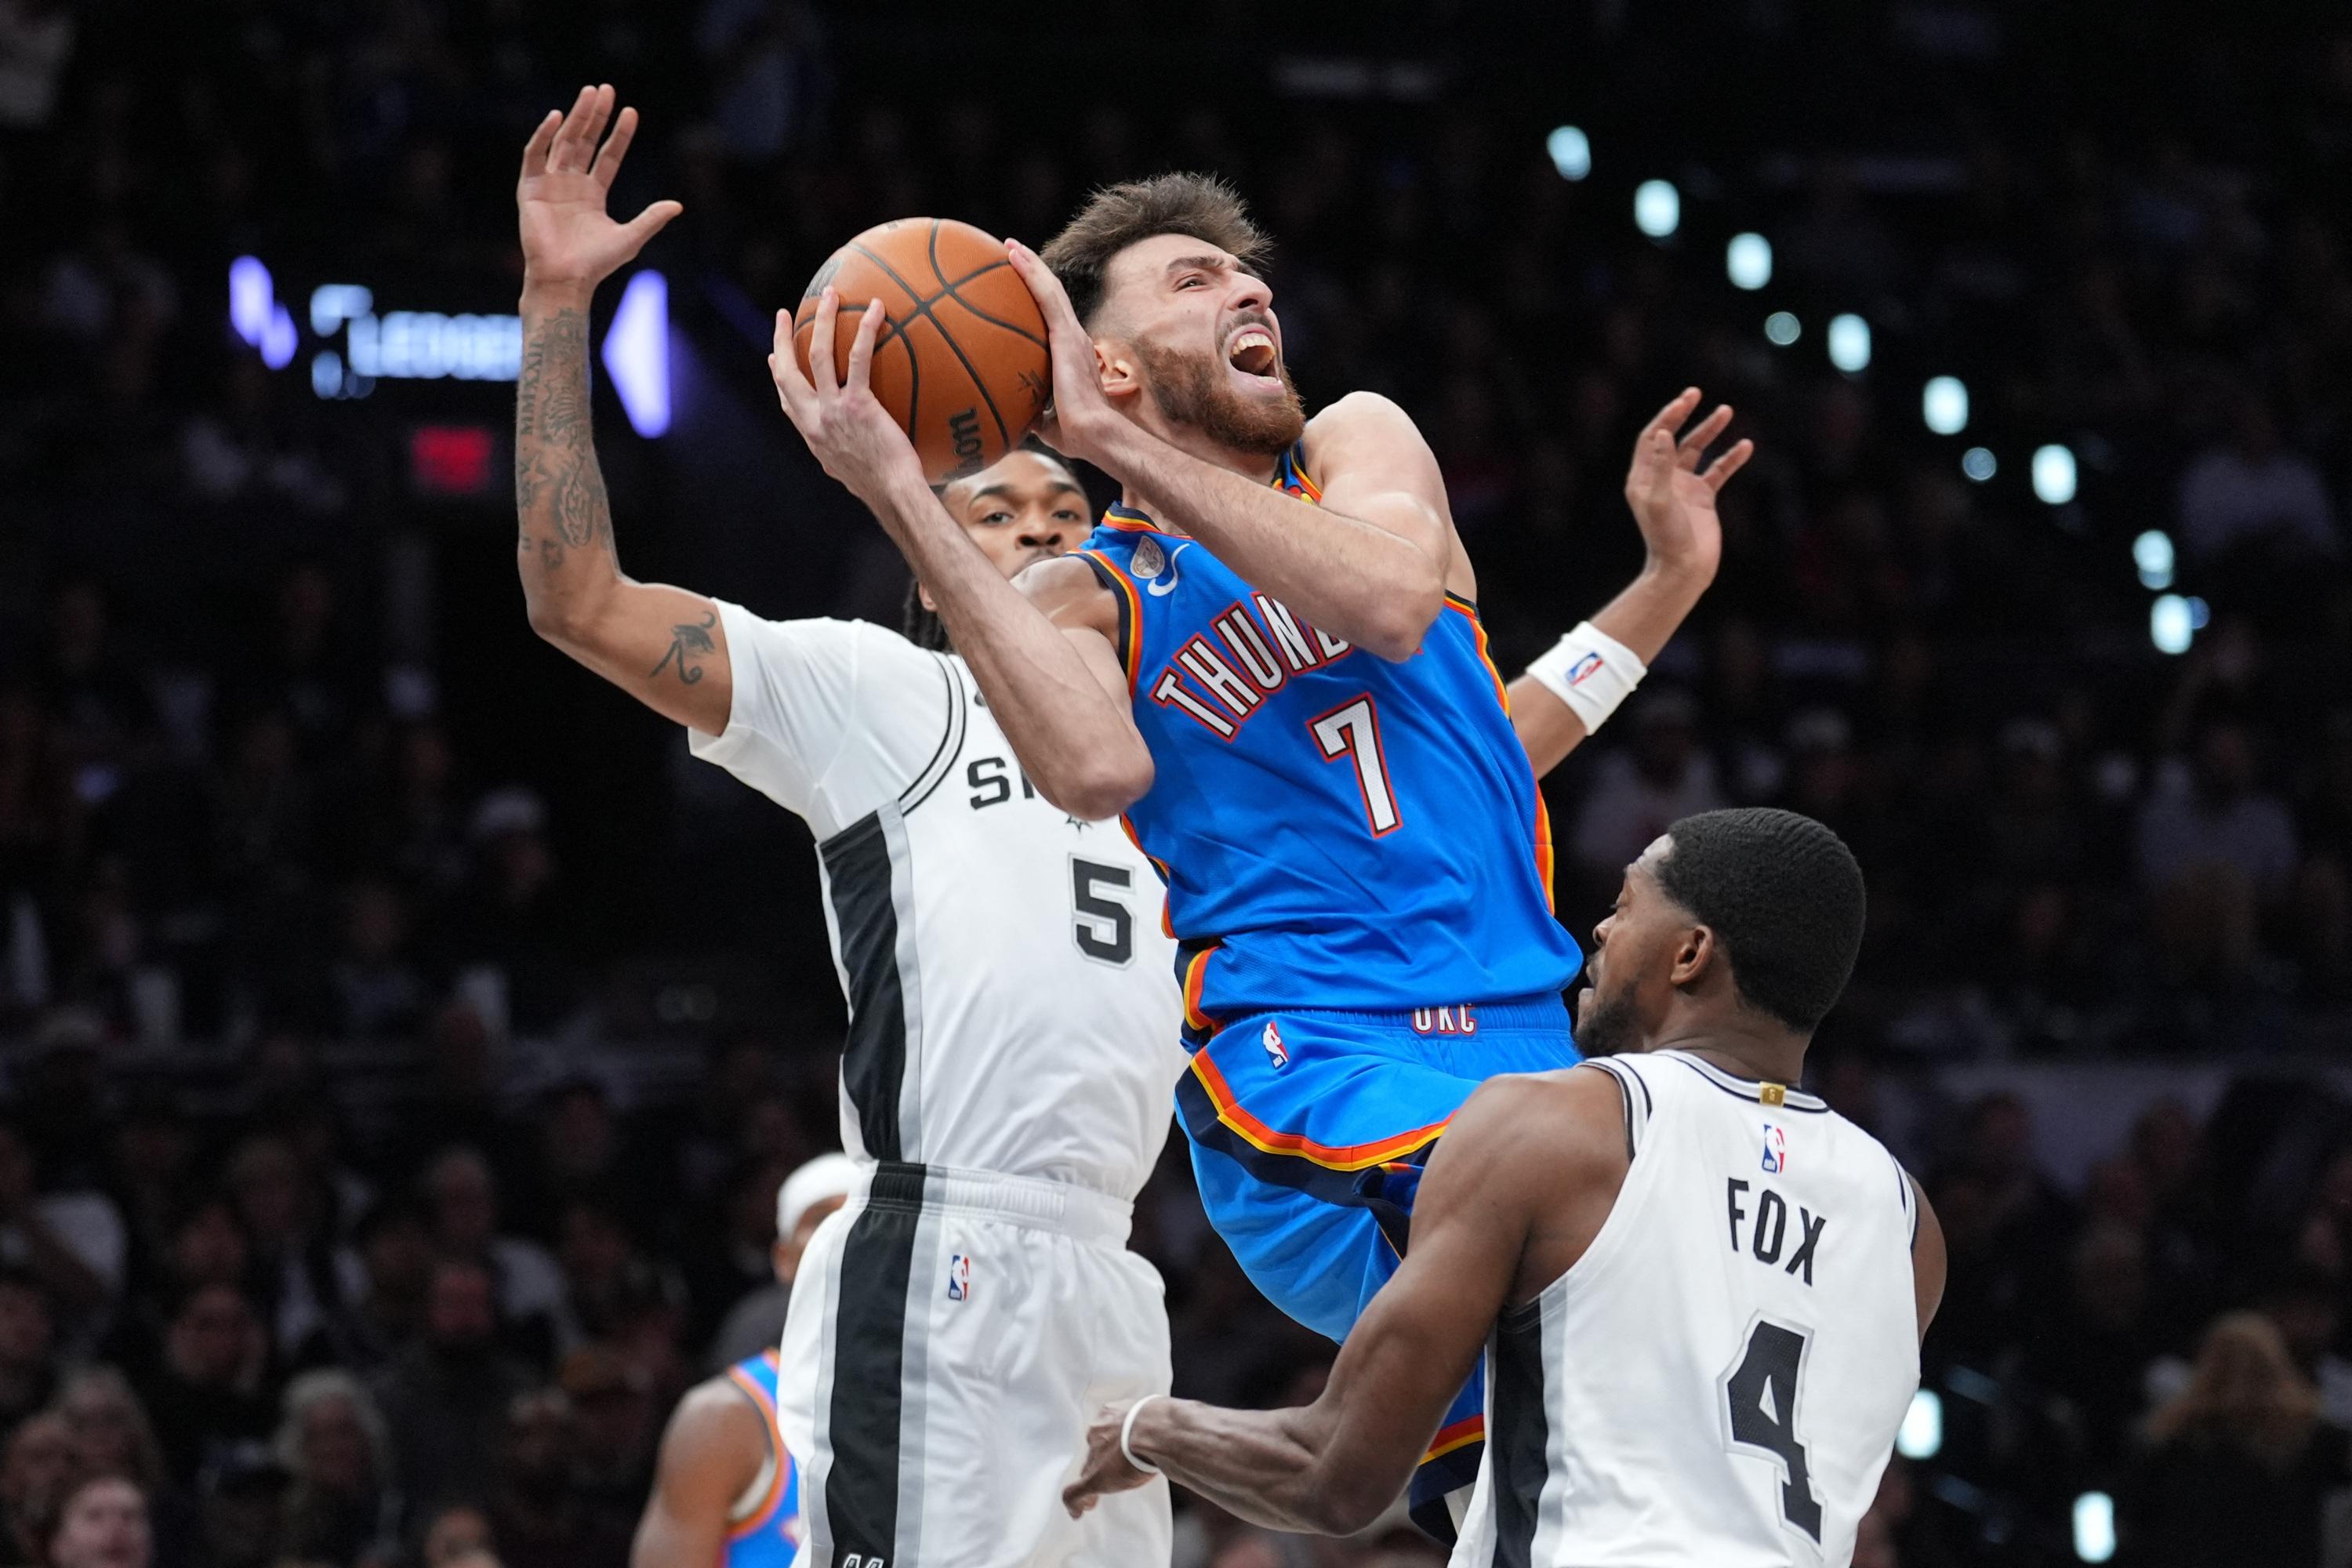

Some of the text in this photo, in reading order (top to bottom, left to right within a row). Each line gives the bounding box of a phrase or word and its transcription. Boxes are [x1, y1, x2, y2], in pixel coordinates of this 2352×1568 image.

[1149, 592, 1356, 743] THUN
[1307, 692, 1403, 839] 7
[1071, 856, 1134, 966] 5
[1728, 1176, 1827, 1287] FOX
[1726, 1318, 1824, 1547] 4
